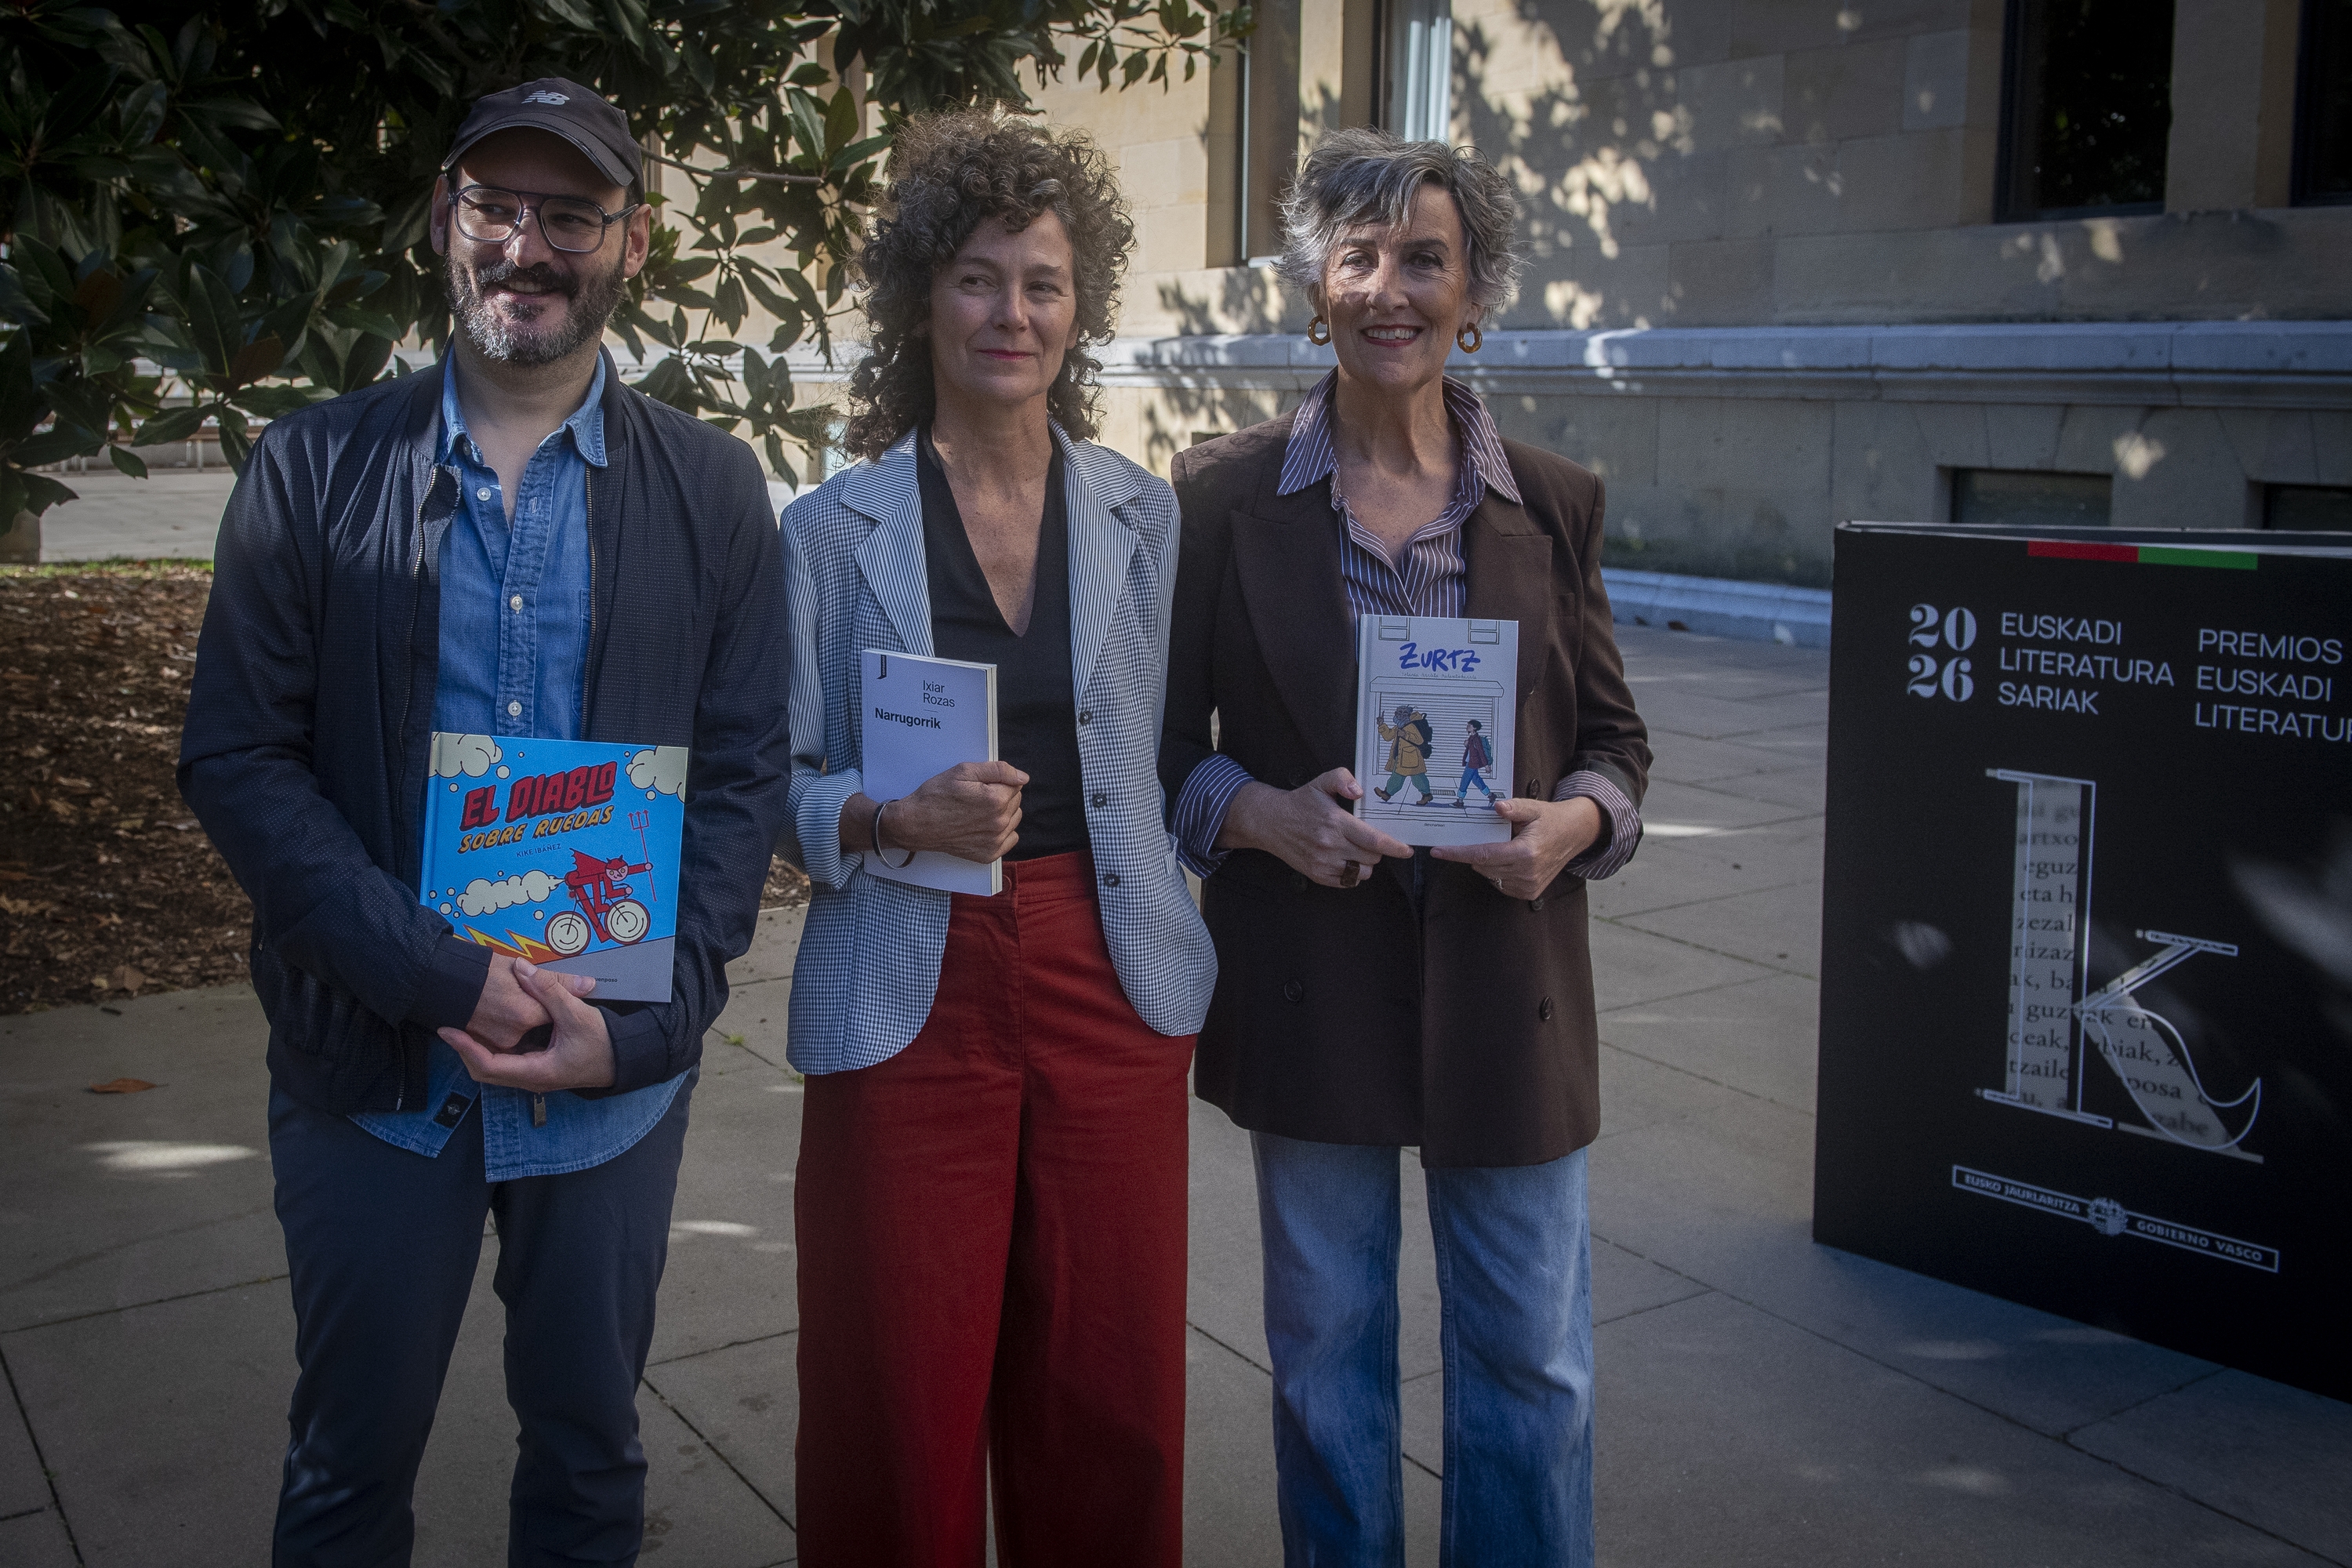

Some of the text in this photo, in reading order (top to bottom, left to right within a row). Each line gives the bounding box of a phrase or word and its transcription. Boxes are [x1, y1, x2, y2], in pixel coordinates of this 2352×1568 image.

[1909, 604, 1977, 651] 20
[2000, 612, 2122, 645] EUSKADI
[2198, 628, 2343, 665] PREMIOS
[1907, 654, 1975, 702] 26
[1998, 647, 2175, 687] LITERATURA
[2196, 665, 2332, 702] EUSKADI
[923, 680, 945, 693] Ixiar
[923, 693, 956, 707] Rozas
[1998, 681, 2100, 715] SARIAK
[875, 707, 941, 729] Narrugorrik
[459, 761, 618, 831] EL DIABLO
[457, 805, 615, 854] SOBRE RUEDAS
[517, 843, 561, 858] KIKE IBÁÑEZ
[1964, 1174, 2263, 1261] EUSKO JAURLARITZA GOBIERNO VASCO
